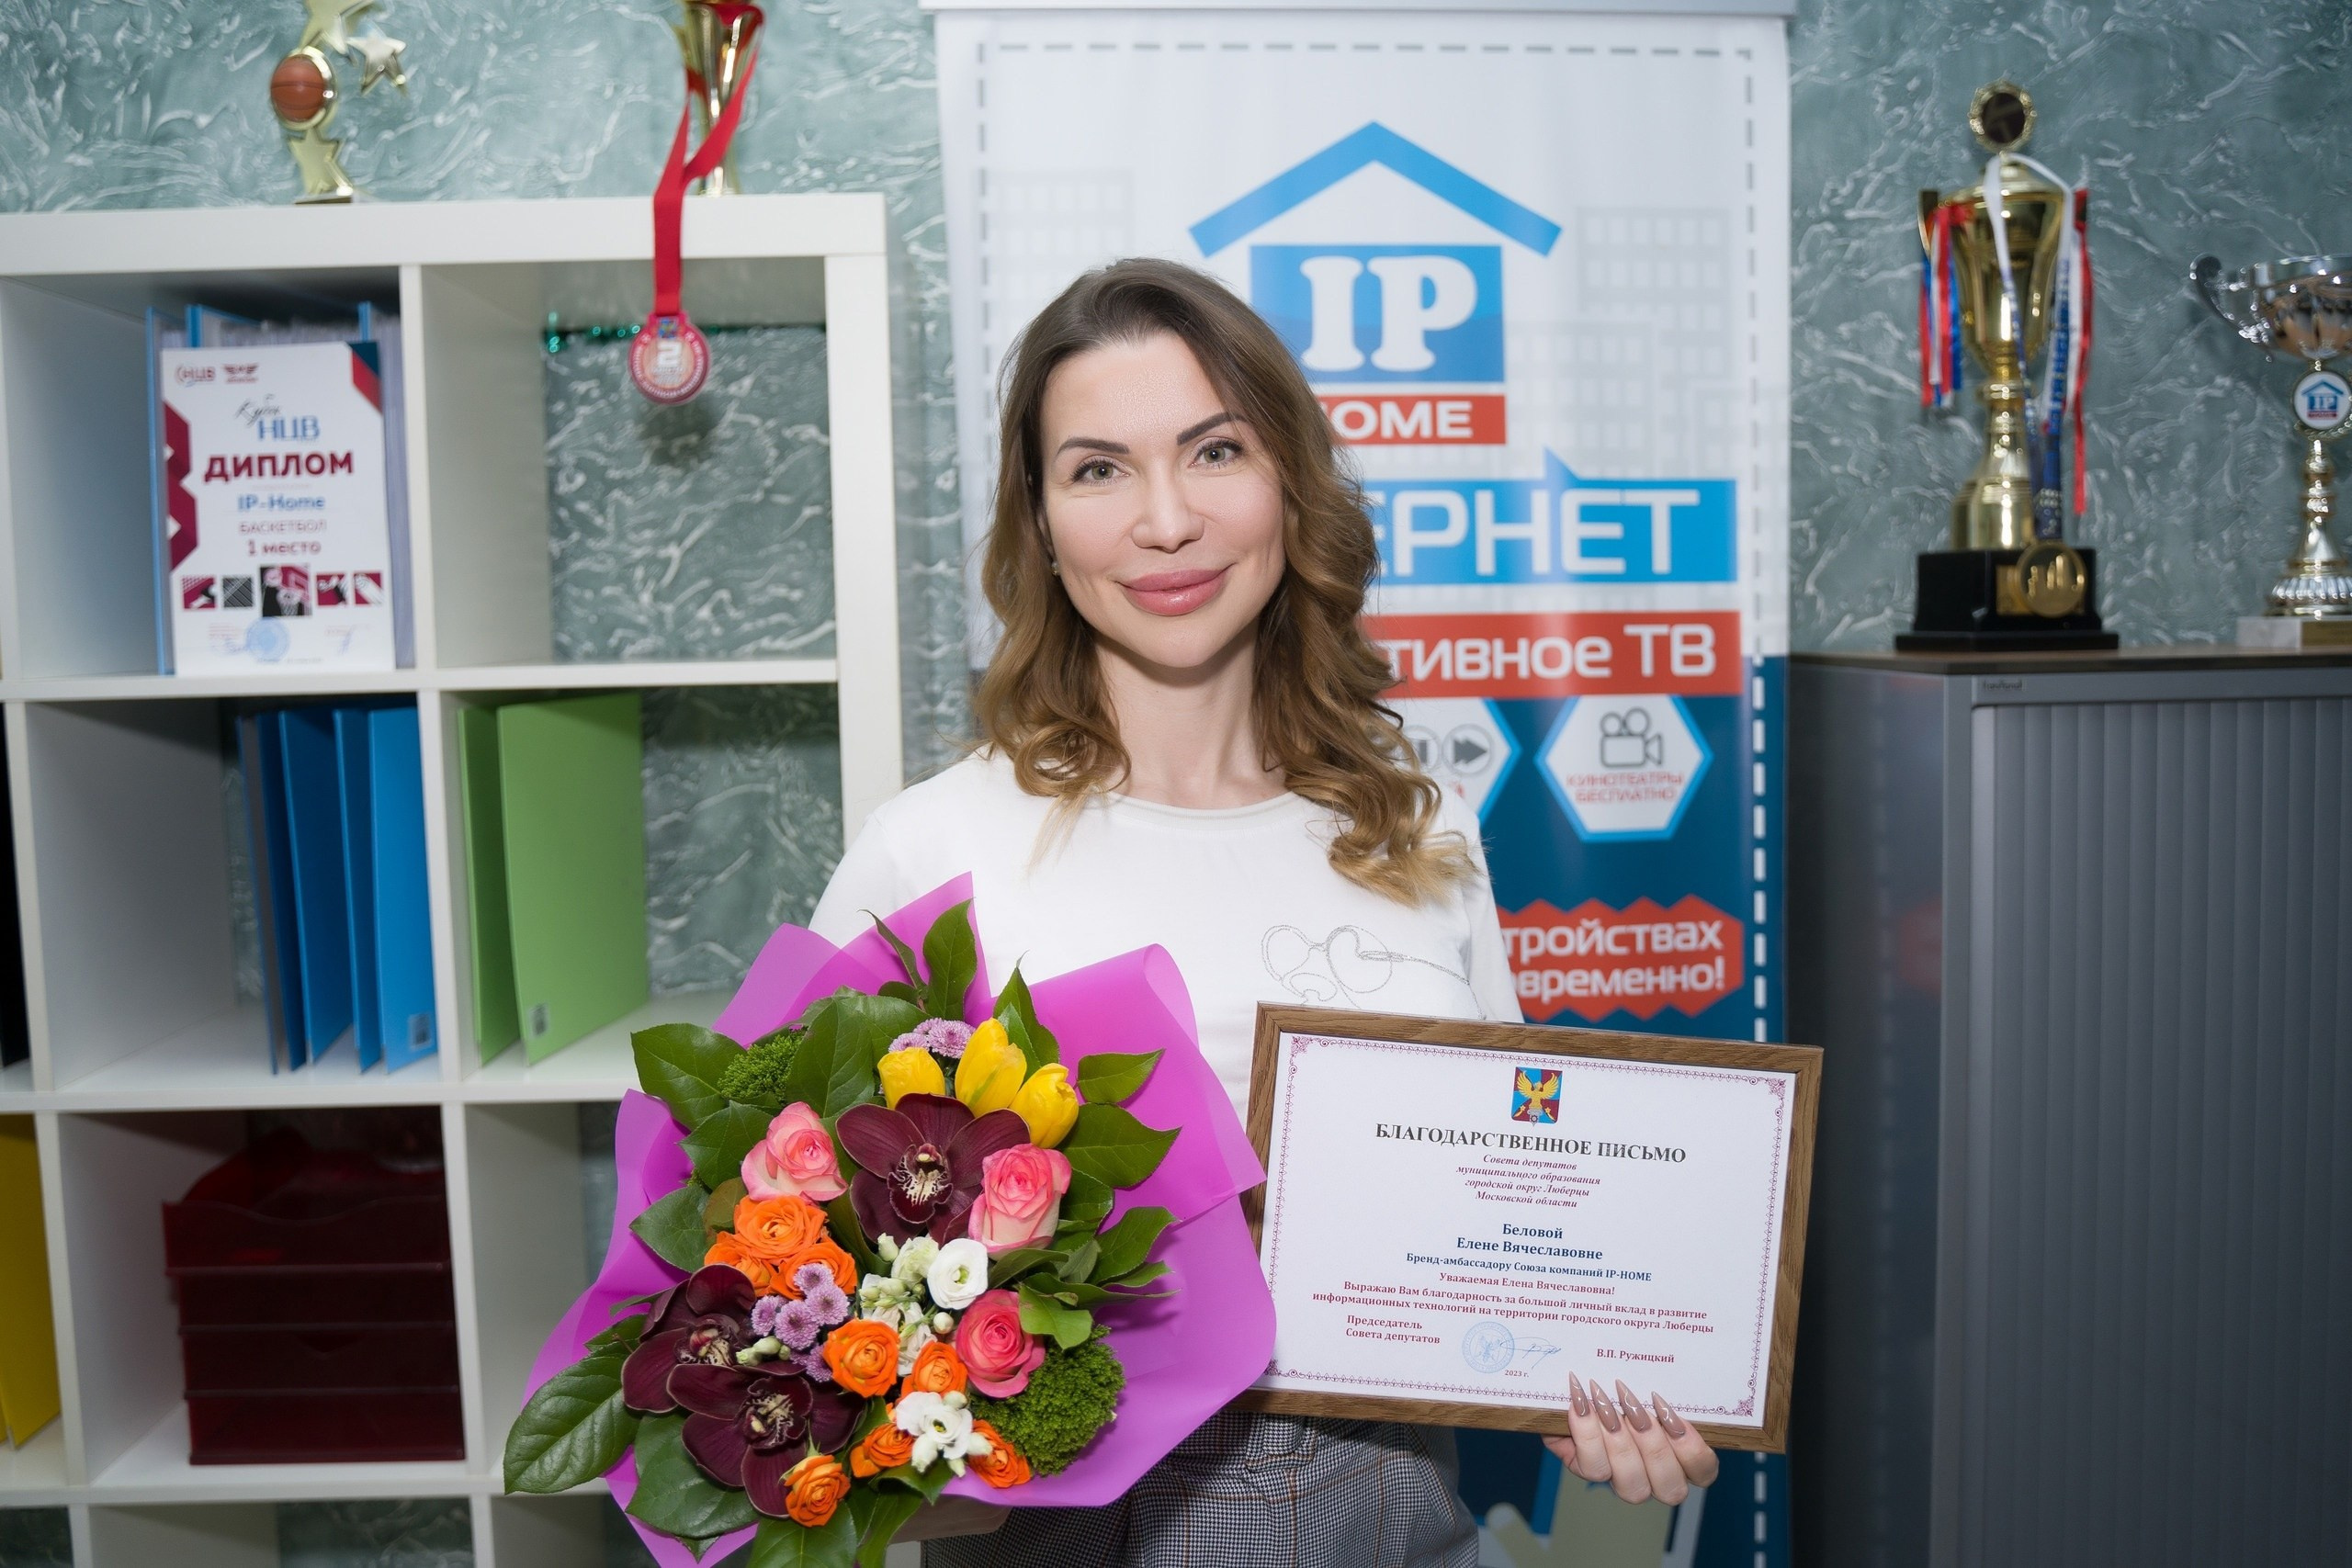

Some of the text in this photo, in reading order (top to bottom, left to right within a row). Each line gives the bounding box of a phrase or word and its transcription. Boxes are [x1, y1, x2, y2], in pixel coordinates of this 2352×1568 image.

[1299, 254, 1478, 372] IP
[1320, 400, 1473, 439] OME
[203, 451, 355, 485] ДИПЛОМ
[238, 494, 326, 512] IP-Home
[240, 519, 327, 533] БАСКЕТБОЛ
[248, 540, 322, 555] 1 место
[1623, 623, 1716, 677] ТВ
[1566, 772, 1683, 786] КИНОТЕАТРЫ
[1576, 787, 1676, 803] БЕСПЛАТНО
[1502, 919, 1724, 964] тройствах
[1374, 1122, 1687, 1164] БЛАГОДАРСТВЕННОЕ ПИСЬМО
[1483, 1153, 1577, 1171] Совета депутатов
[1455, 1166, 1601, 1185] муниципального образования
[1464, 1179, 1590, 1198] городской округ Люберцы
[1475, 1190, 1577, 1208] Московской области
[1501, 1223, 1564, 1240] Беловой
[1455, 1236, 1603, 1260] Елене Вячеславовне
[1406, 1252, 1653, 1282] Бренд-амбассадору Союза компаний IP-HOME
[1439, 1271, 1615, 1295] Уважаемая Елена Вячеславовна!
[1343, 1280, 1396, 1294] Выражаю
[1398, 1285, 1420, 1296] Вам
[1421, 1287, 1503, 1303] благодарность
[1504, 1296, 1517, 1304] за
[1518, 1295, 1567, 1308] большой
[1569, 1301, 1612, 1313] личный
[1614, 1305, 1647, 1317] вклад
[1657, 1308, 1708, 1320] развитие
[1312, 1292, 1714, 1335] информационных технологий на территории городского округа Люберцы
[1346, 1314, 1423, 1330] Председатель
[1345, 1327, 1441, 1345] Совета депутатов
[1596, 1348, 1675, 1364] В.П. Ружицкий
[1504, 1370, 1522, 1378] 2023
